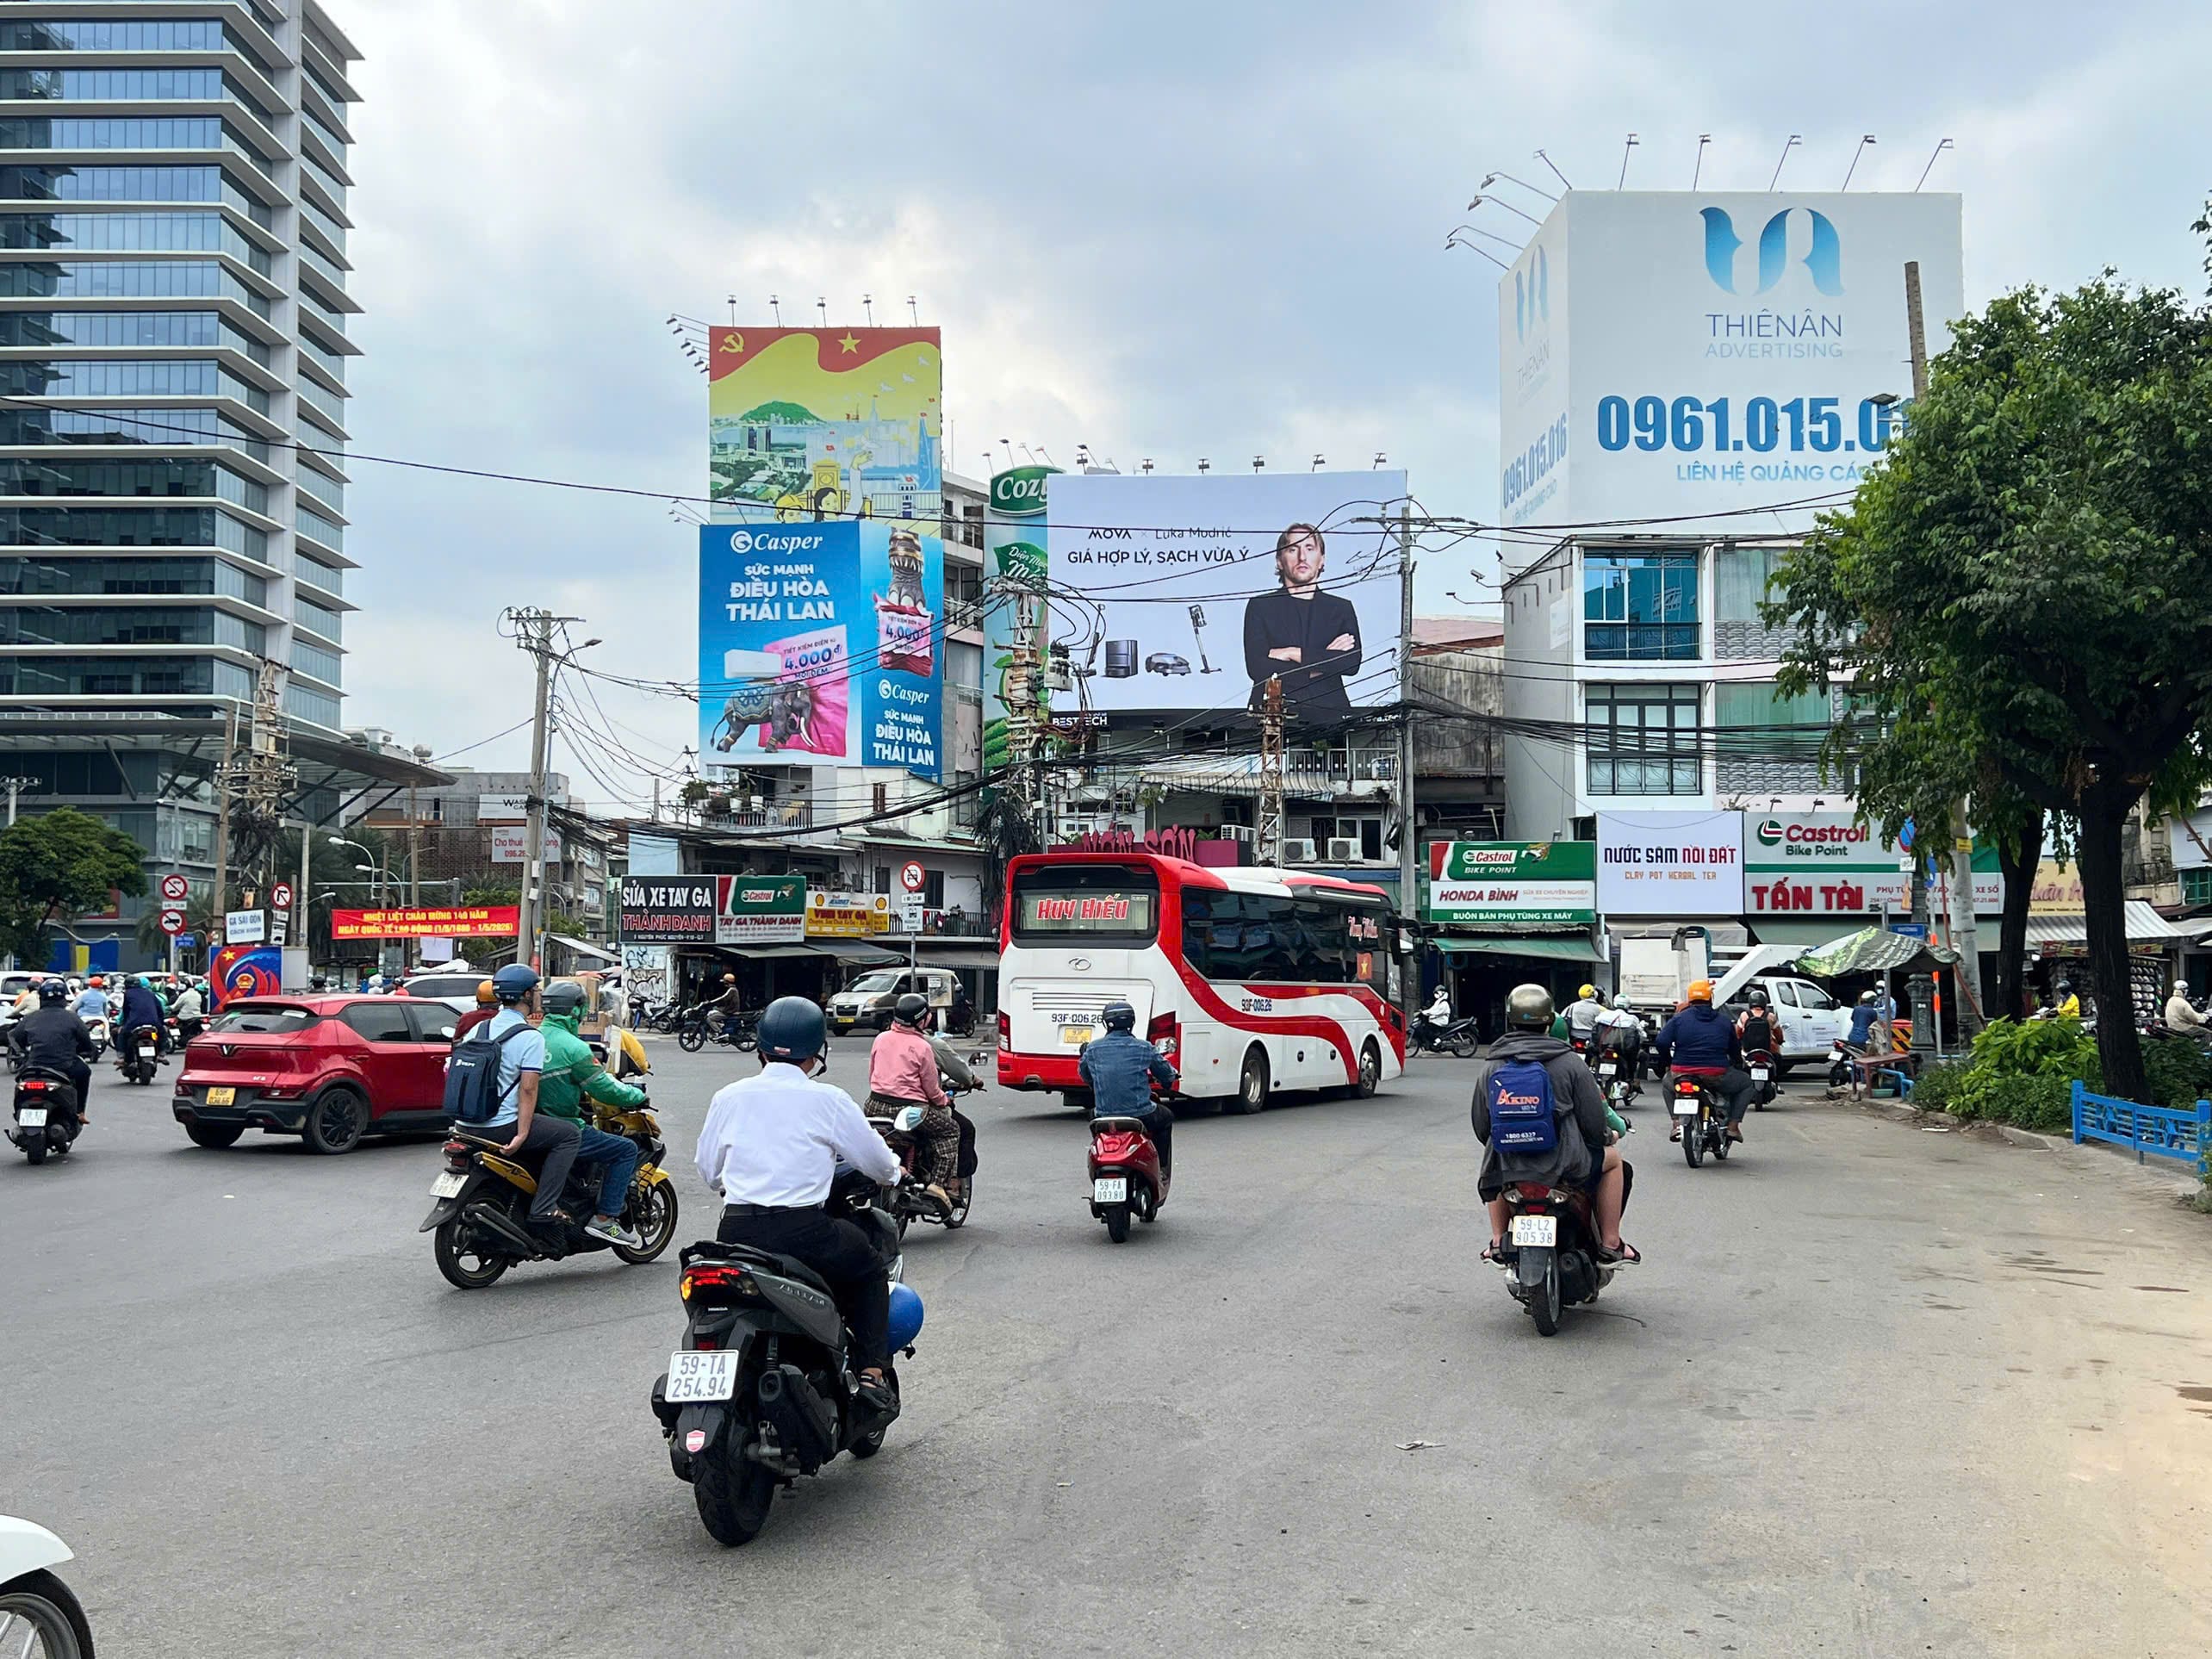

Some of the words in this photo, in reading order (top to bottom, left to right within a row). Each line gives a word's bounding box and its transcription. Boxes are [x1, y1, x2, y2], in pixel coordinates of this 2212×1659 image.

[1705, 343, 1842, 358] ADVERTISING
[1598, 395, 1914, 452] 0961.015.0
[1502, 411, 1567, 510] 0961.015.016
[1677, 460, 1716, 481] LIÊN
[1721, 460, 1745, 486] HỆ
[1750, 460, 1824, 482] QUẢNG
[1156, 528, 1184, 539] Luka
[1190, 526, 1232, 538] Modrić
[754, 532, 823, 555] Casper
[1067, 548, 1093, 563] GIÁ
[1097, 549, 1130, 567] HỢP
[1134, 548, 1152, 565] LÝ,
[1157, 550, 1198, 565] SẠCH
[1202, 546, 1235, 562] VỪA
[1240, 546, 1249, 560] Ý
[744, 562, 770, 575] SỨC
[774, 564, 814, 576] MẠNH
[730, 577, 778, 598] ĐIỀU
[783, 576, 830, 597] HÒA
[726, 600, 780, 621] THÁI
[787, 601, 835, 621] LAN
[892, 683, 930, 705] Casper
[884, 708, 900, 719] SỨC
[901, 711, 924, 725] MẠNH
[1053, 716, 1108, 726] BESTECH
[875, 719, 904, 741] ĐIỀU
[906, 724, 932, 746] HÒA
[873, 741, 905, 761] THÁI
[908, 747, 935, 766] LAN
[1786, 824, 1867, 842] Castrol
[1476, 851, 1513, 862] Castrol
[1604, 843, 1641, 863] NƯỚC
[1646, 846, 1678, 863] SÂM
[1682, 844, 1705, 863] NỒI
[1709, 844, 1737, 864] ĐẤT
[1786, 845, 1812, 855] Bike
[1815, 845, 1849, 855] Point
[1625, 871, 1643, 879] CLAY
[1650, 871, 1662, 879] POT
[1702, 871, 1717, 879] TEA
[623, 879, 646, 907] SỬA
[649, 887, 668, 907] XE
[668, 887, 689, 907] TAY
[692, 887, 711, 907] GA
[749, 891, 773, 901] Castrol
[1439, 890, 1484, 901] HONDA
[1488, 887, 1519, 901] BÌNH
[1751, 877, 1813, 910] TẤN
[1819, 879, 1863, 910] TÀI
[1987, 884, 1999, 893] SỐ
[1037, 898, 1078, 920] HUY
[1080, 893, 1129, 920] HIẾU
[1453, 911, 1477, 920] BUÔN
[1479, 911, 1497, 920] BÁN
[1517, 911, 1540, 920] TÙNG
[623, 909, 671, 931] THÀNH
[672, 914, 711, 931] DANH
[720, 917, 734, 926] TAY
[749, 915, 777, 926] THÀNH
[680, 1355, 726, 1376] 59-TA
[672, 1377, 727, 1398] 254.94
